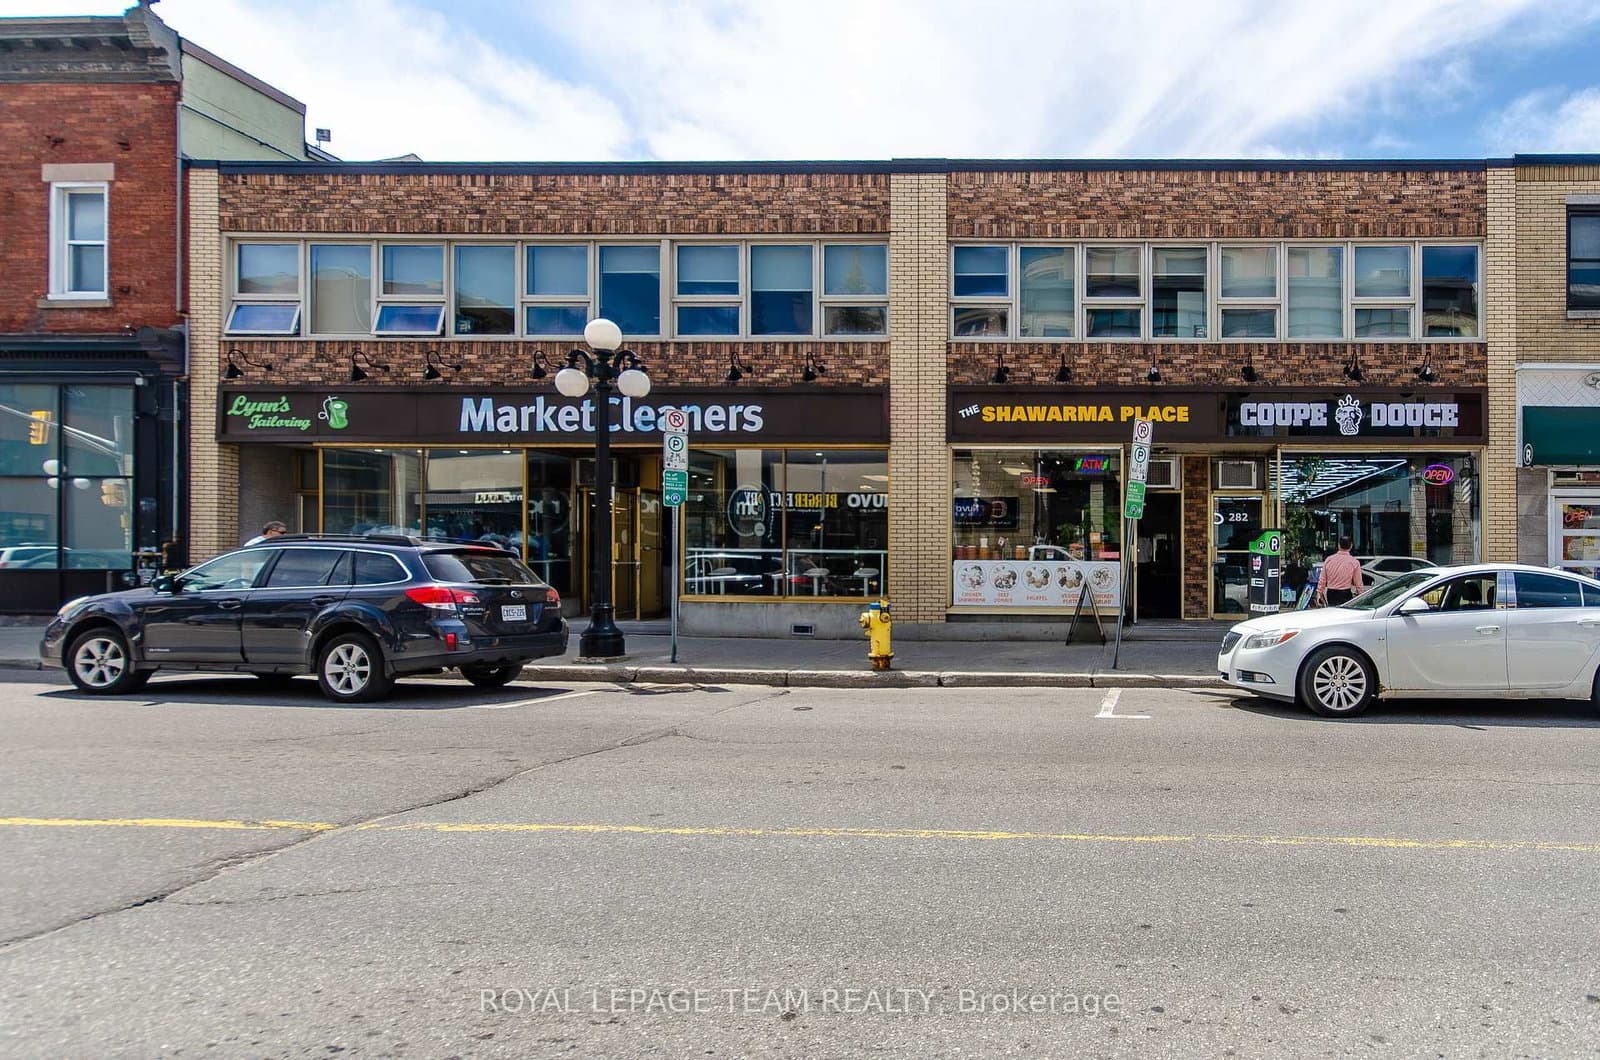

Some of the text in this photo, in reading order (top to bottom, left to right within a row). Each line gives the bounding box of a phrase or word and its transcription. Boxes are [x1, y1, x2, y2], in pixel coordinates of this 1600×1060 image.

[227, 394, 291, 417] Lynn's
[958, 403, 1190, 422] THE SHAWARMA PLACE
[247, 413, 312, 431] Tailoring
[459, 396, 596, 433] Market
[1240, 402, 1459, 427] COUPE DOUCE
[1081, 458, 1103, 470] ATM
[1022, 475, 1049, 486] OPEN
[1424, 468, 1451, 482] OPEN
[1228, 512, 1249, 522] 282
[1564, 509, 1593, 523] OPEN
